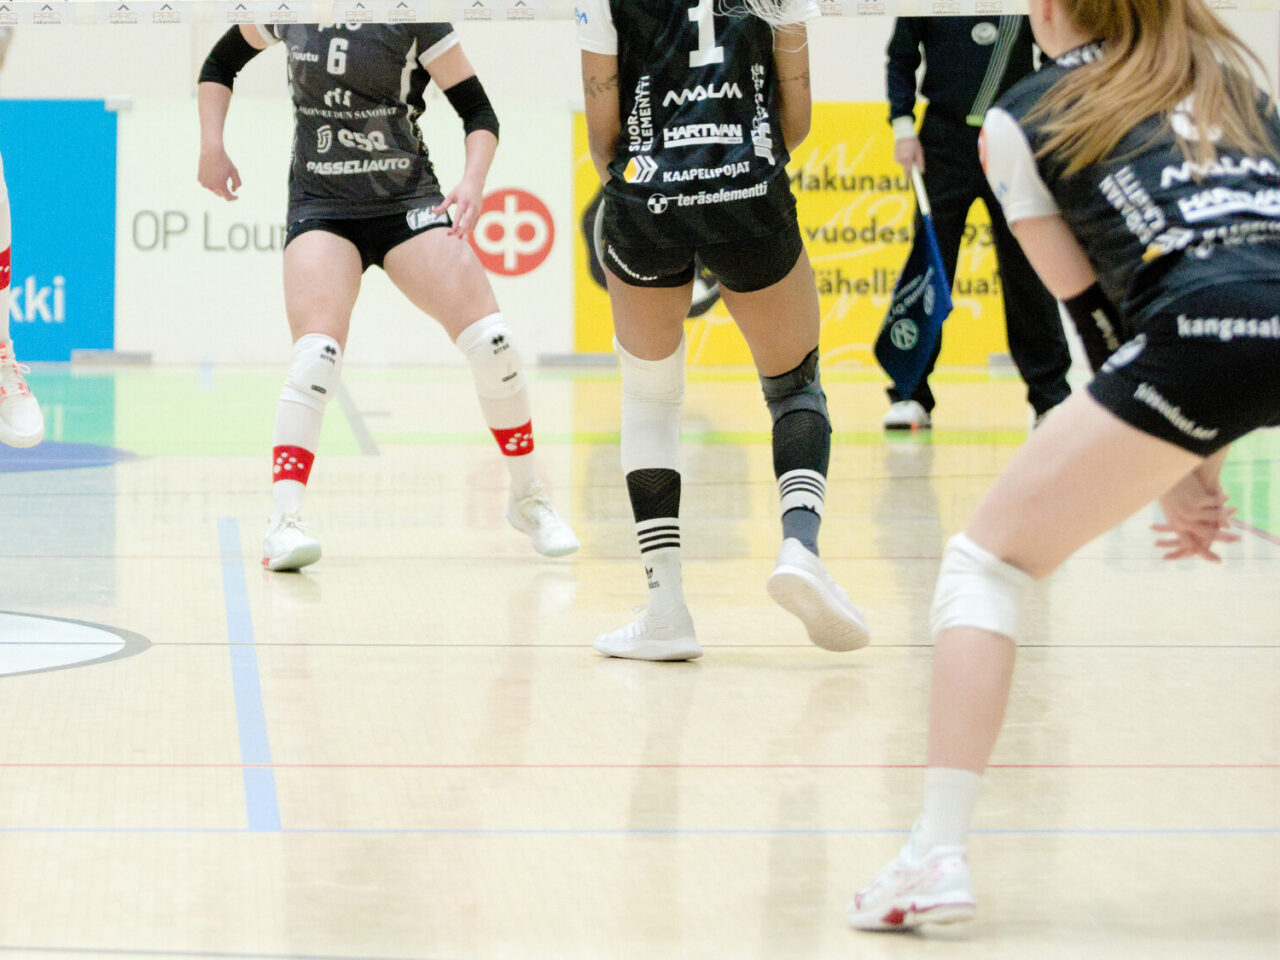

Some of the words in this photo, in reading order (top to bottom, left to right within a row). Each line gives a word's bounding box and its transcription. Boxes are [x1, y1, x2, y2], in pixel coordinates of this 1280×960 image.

[327, 37, 349, 76] 6
[663, 123, 743, 143] HARTMAN
[663, 161, 751, 183] KAAPELIPOJAT
[677, 181, 768, 208] teräselementti
[132, 209, 188, 252] OP
